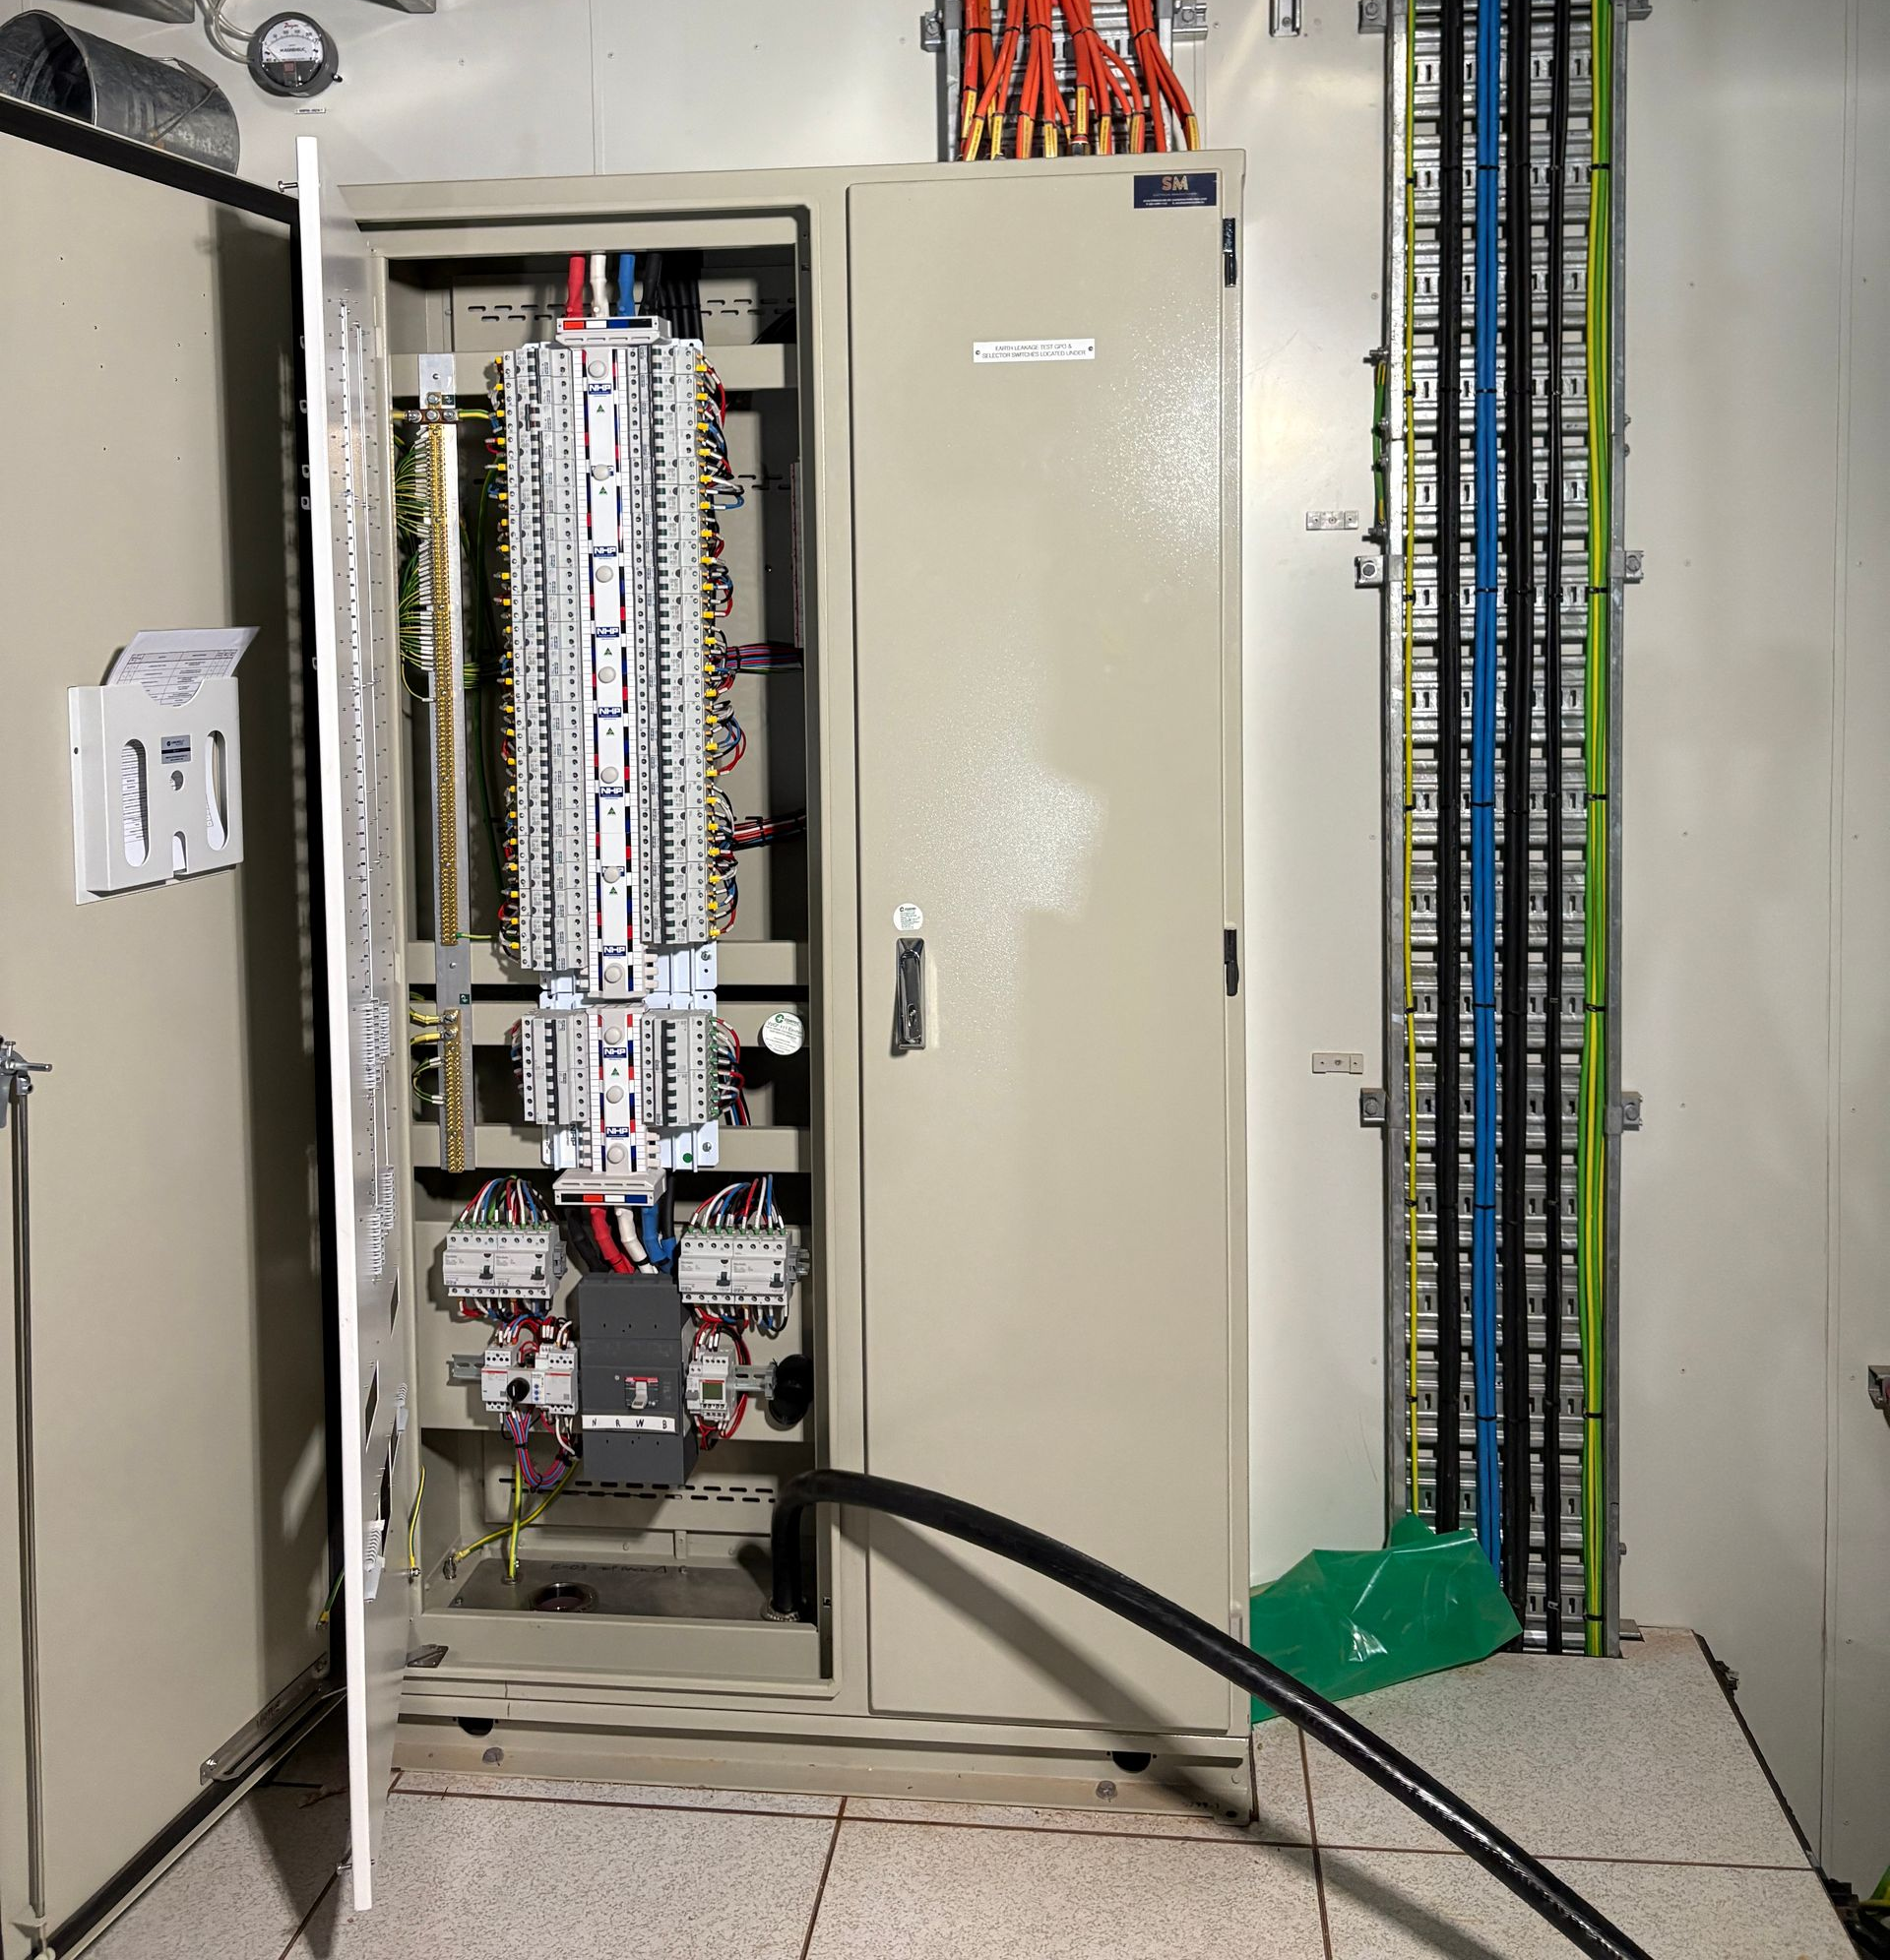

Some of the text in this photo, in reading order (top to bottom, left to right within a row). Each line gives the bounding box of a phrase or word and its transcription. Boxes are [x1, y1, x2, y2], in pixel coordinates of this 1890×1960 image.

[1162, 175, 1189, 191] SM
[592, 1418, 667, 1429] N R W B
